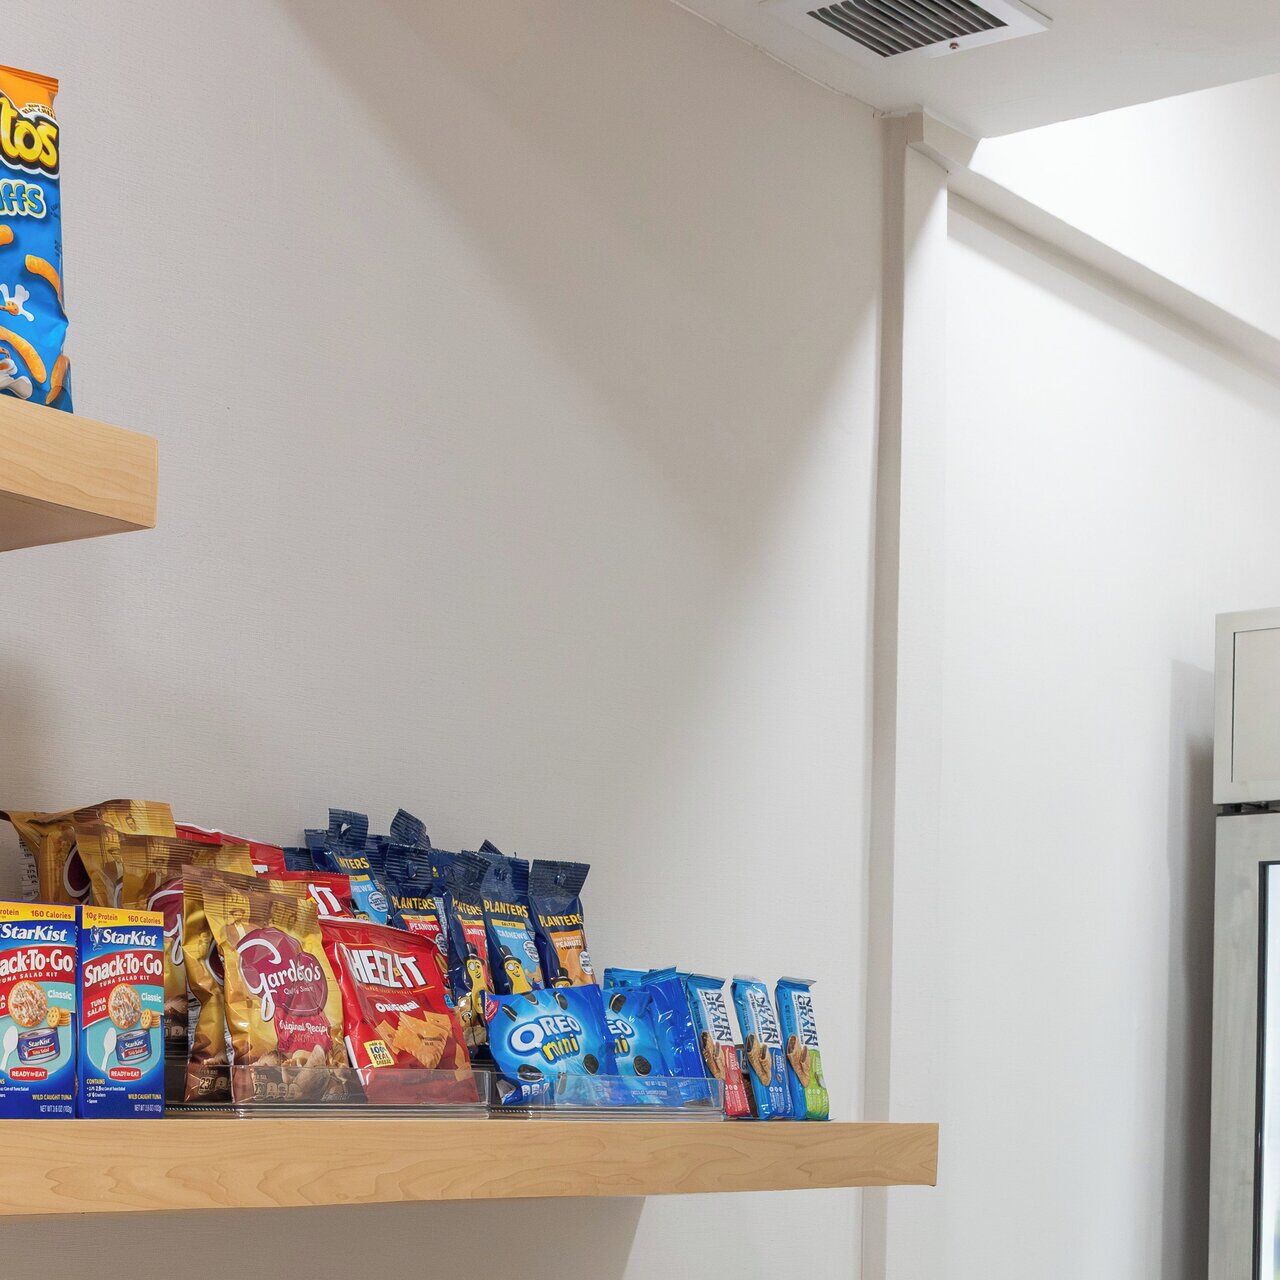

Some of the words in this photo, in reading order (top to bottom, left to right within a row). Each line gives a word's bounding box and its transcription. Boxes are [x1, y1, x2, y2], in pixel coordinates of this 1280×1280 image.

[393, 896, 435, 911] PLANTERS
[484, 899, 528, 918] PLANTERS
[45, 911, 71, 919] Calories
[0, 924, 67, 942] StarKist
[102, 927, 158, 946] StarKist
[497, 929, 527, 940] CASHEWS
[48, 990, 72, 1000] Classic
[511, 1015, 580, 1052] OREO
[542, 1034, 579, 1062] mini
